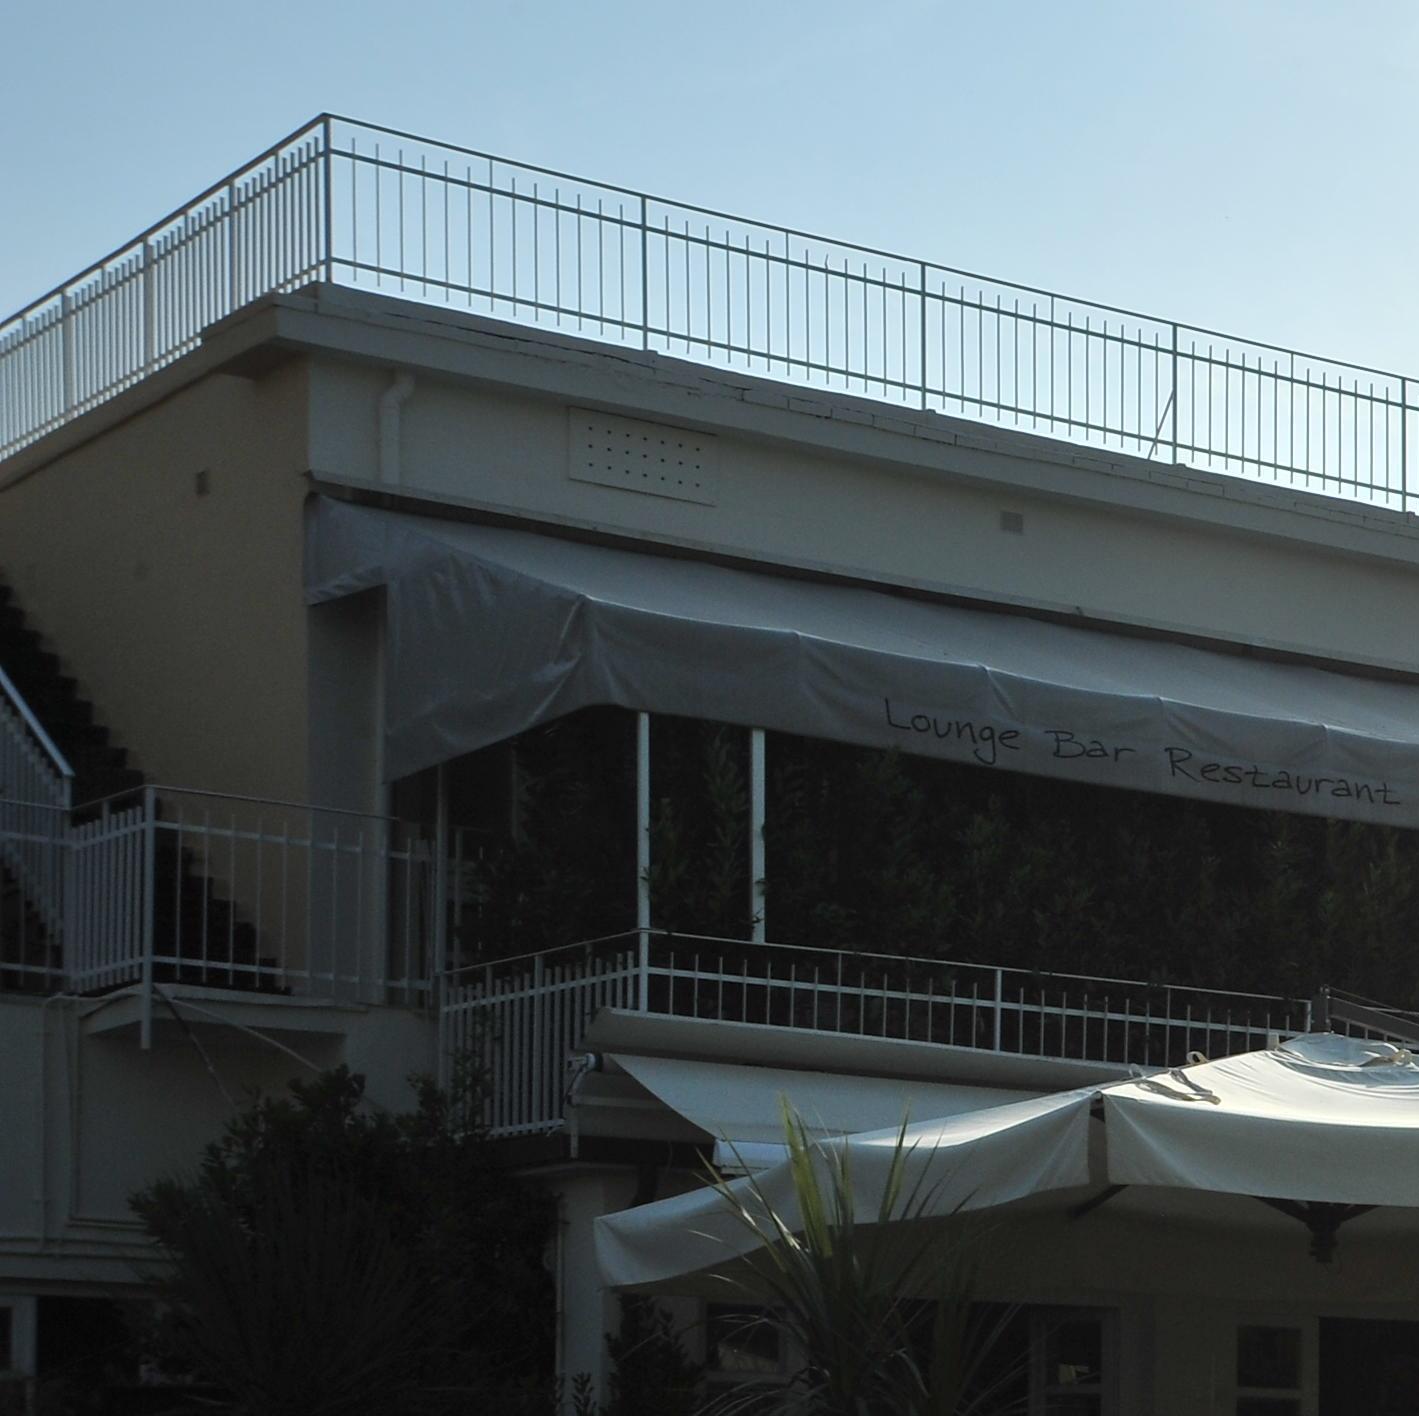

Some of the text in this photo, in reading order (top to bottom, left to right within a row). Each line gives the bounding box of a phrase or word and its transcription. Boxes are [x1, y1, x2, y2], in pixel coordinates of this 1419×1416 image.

[884, 698, 1401, 806] Lounge Bar Restaurant
